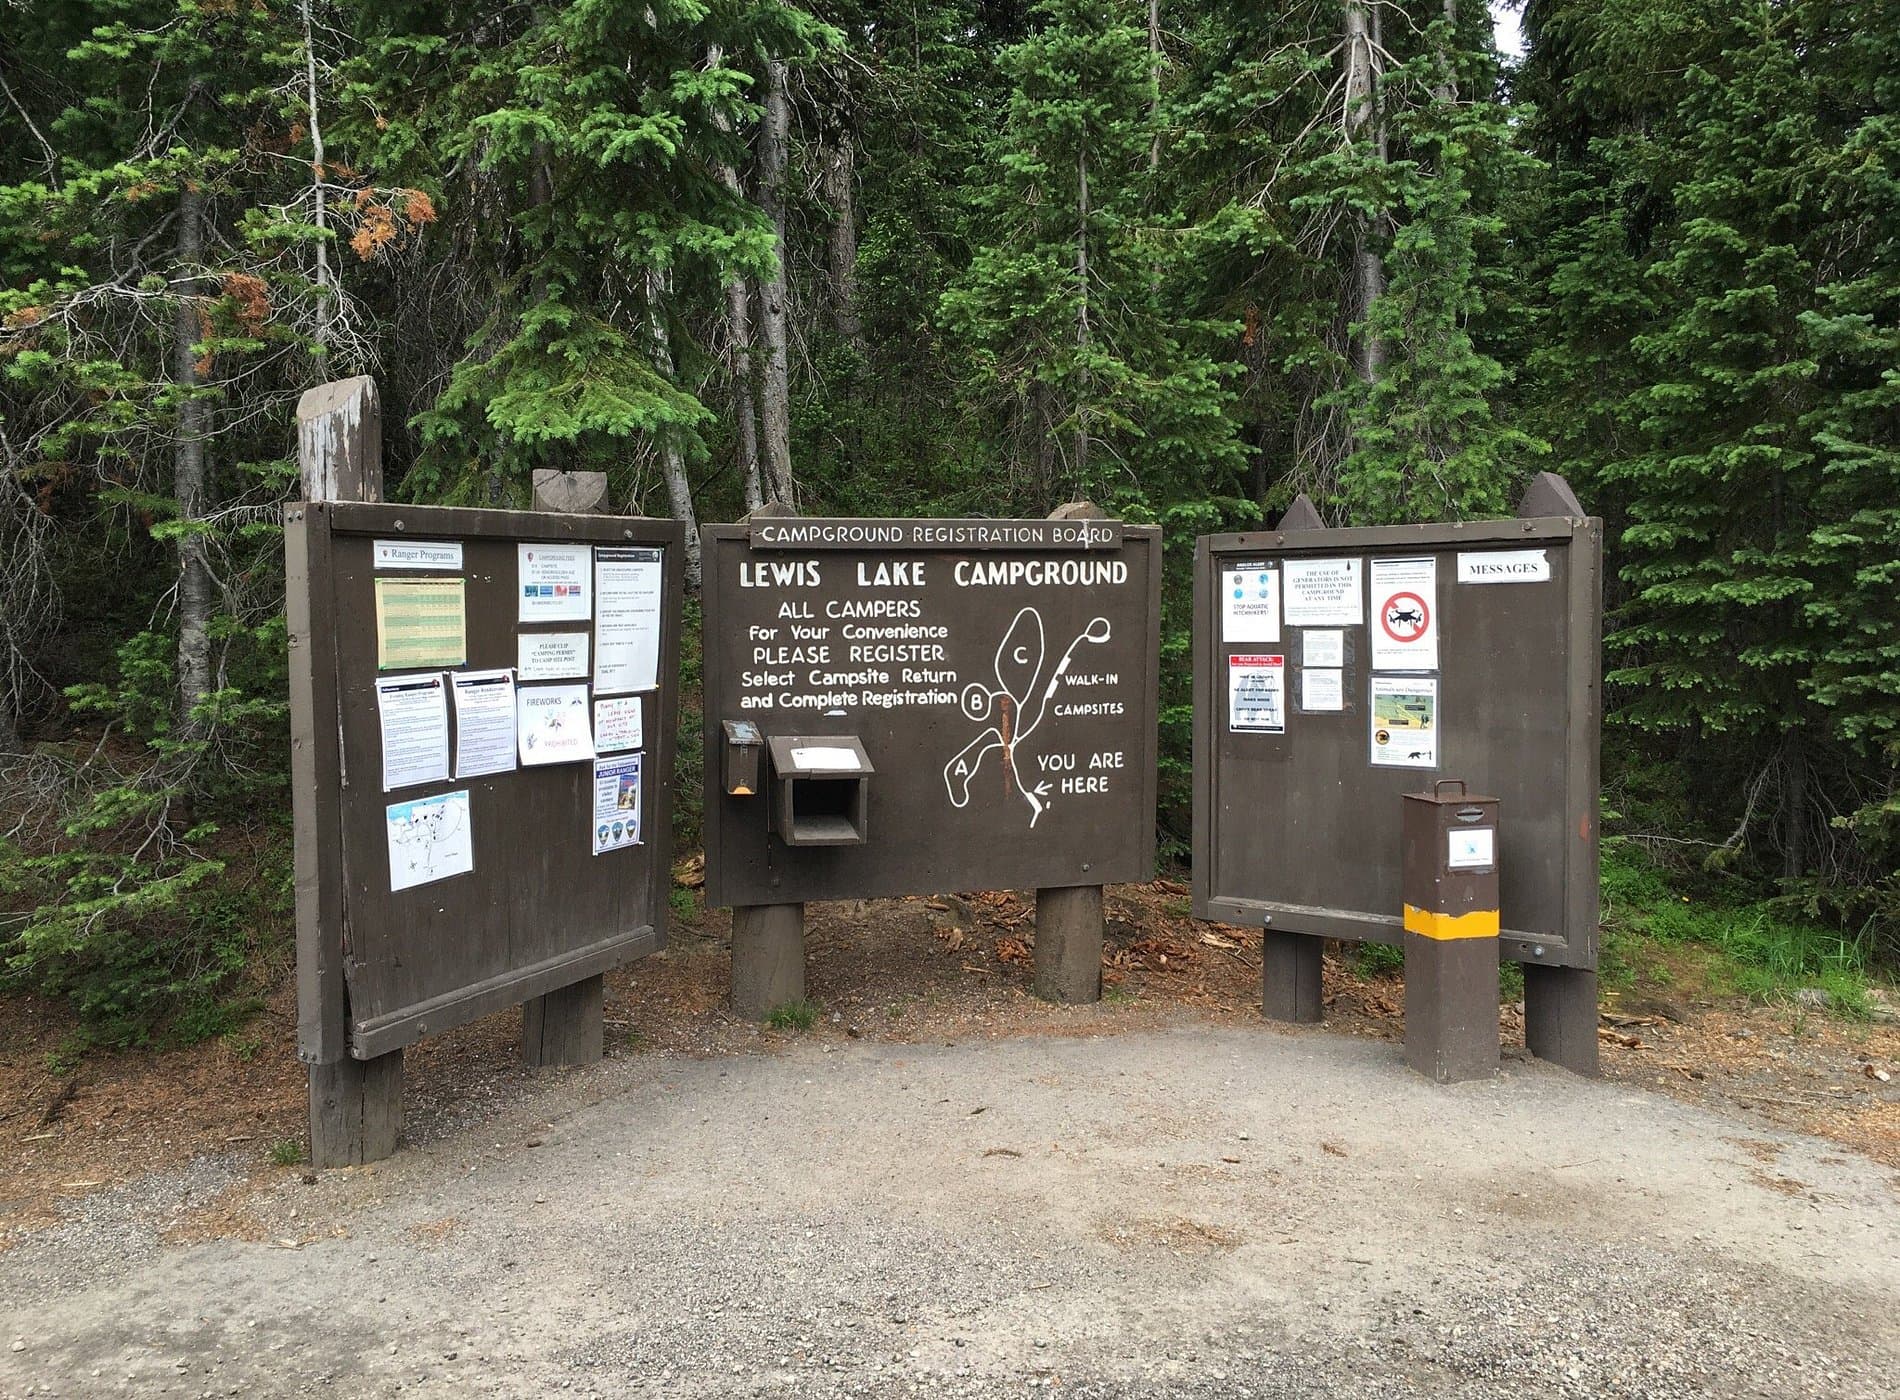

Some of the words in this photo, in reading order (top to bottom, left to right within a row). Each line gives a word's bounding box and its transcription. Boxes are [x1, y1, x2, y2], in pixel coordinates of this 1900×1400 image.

[762, 526, 903, 542] CAMPGROUND
[913, 527, 1043, 543] REGISTRATION
[1053, 527, 1112, 543] BOARD
[391, 549, 418, 560] Ranger
[420, 550, 454, 561] Programs
[740, 560, 821, 587] LEWIS
[857, 561, 926, 587] LAKE
[954, 560, 1128, 587] CAMPGROUND
[1469, 563, 1538, 575] MESSAGES
[778, 601, 815, 619] ALL
[826, 600, 921, 618] CAMPERS
[750, 626, 778, 640] For
[791, 625, 830, 640] Your
[842, 623, 948, 640] Convenience
[753, 646, 831, 664] PLEASE
[849, 644, 945, 662] REGISTER
[1013, 646, 1028, 664] C
[741, 670, 795, 687] Select
[808, 668, 890, 687] Campsite
[902, 668, 957, 684] Return
[1065, 673, 1118, 686] WALK-IN
[526, 697, 562, 706] FIREWORKS
[740, 693, 773, 708] and
[779, 691, 858, 710] Complete
[862, 688, 958, 709] Registration
[970, 694, 983, 710] B
[1054, 702, 1124, 716] CAMPSITES
[954, 759, 968, 776] A
[1038, 753, 1075, 771] YOU
[1089, 752, 1124, 769] ARE
[598, 768, 616, 778] JUNIOR
[616, 765, 636, 775] RANGER
[1061, 776, 1109, 794] HERE
